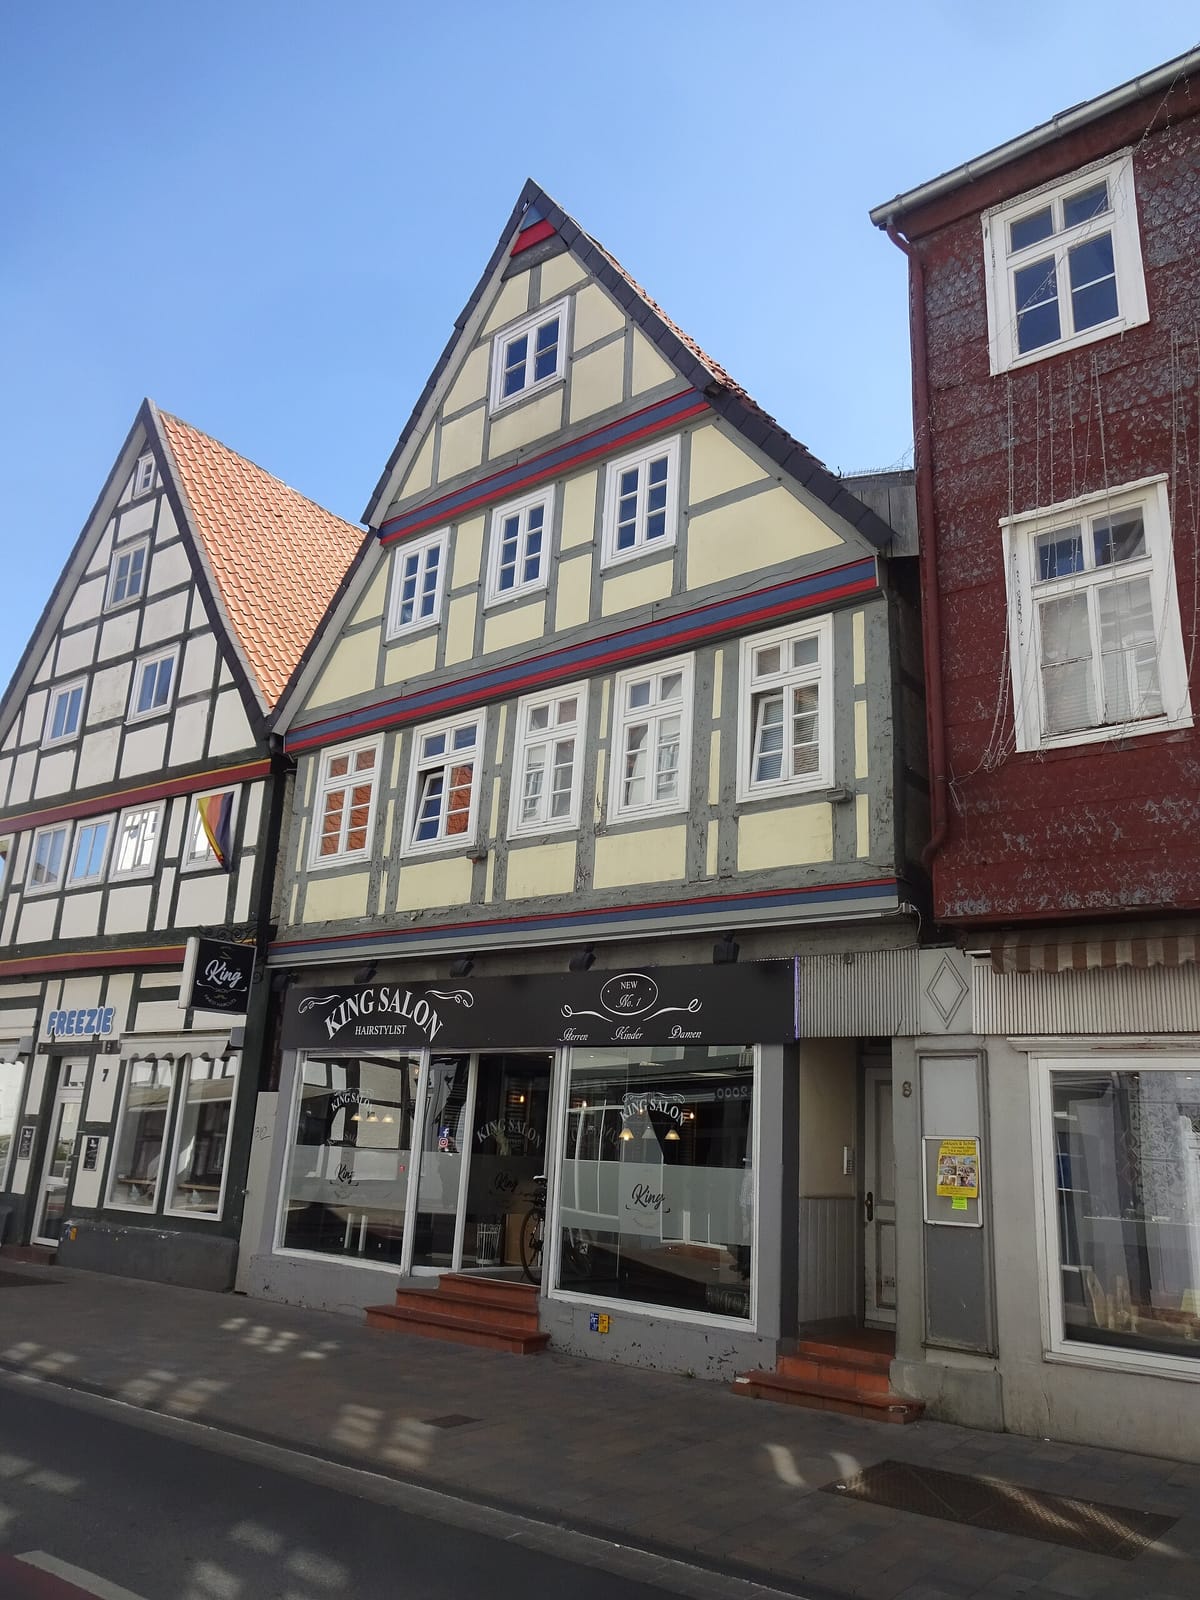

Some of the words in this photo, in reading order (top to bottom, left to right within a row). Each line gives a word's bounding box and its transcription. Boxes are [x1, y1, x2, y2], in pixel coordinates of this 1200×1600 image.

[205, 959, 243, 988] King
[620, 980, 639, 991] NEW
[46, 1006, 115, 1037] FREEZIE
[324, 988, 375, 1040] KING
[377, 987, 443, 1042] SALON
[354, 1024, 407, 1036] HAIRSTYLIST
[557, 1026, 589, 1042] Herren
[610, 1025, 644, 1041] Kinder
[667, 1024, 702, 1040] Damen
[102, 1068, 110, 1082] 7
[902, 1080, 913, 1098] 8
[331, 1094, 350, 1112] KING
[619, 1099, 648, 1122] KING
[649, 1098, 686, 1127] SALON
[477, 1118, 506, 1144] KING
[631, 1183, 665, 1210] King
